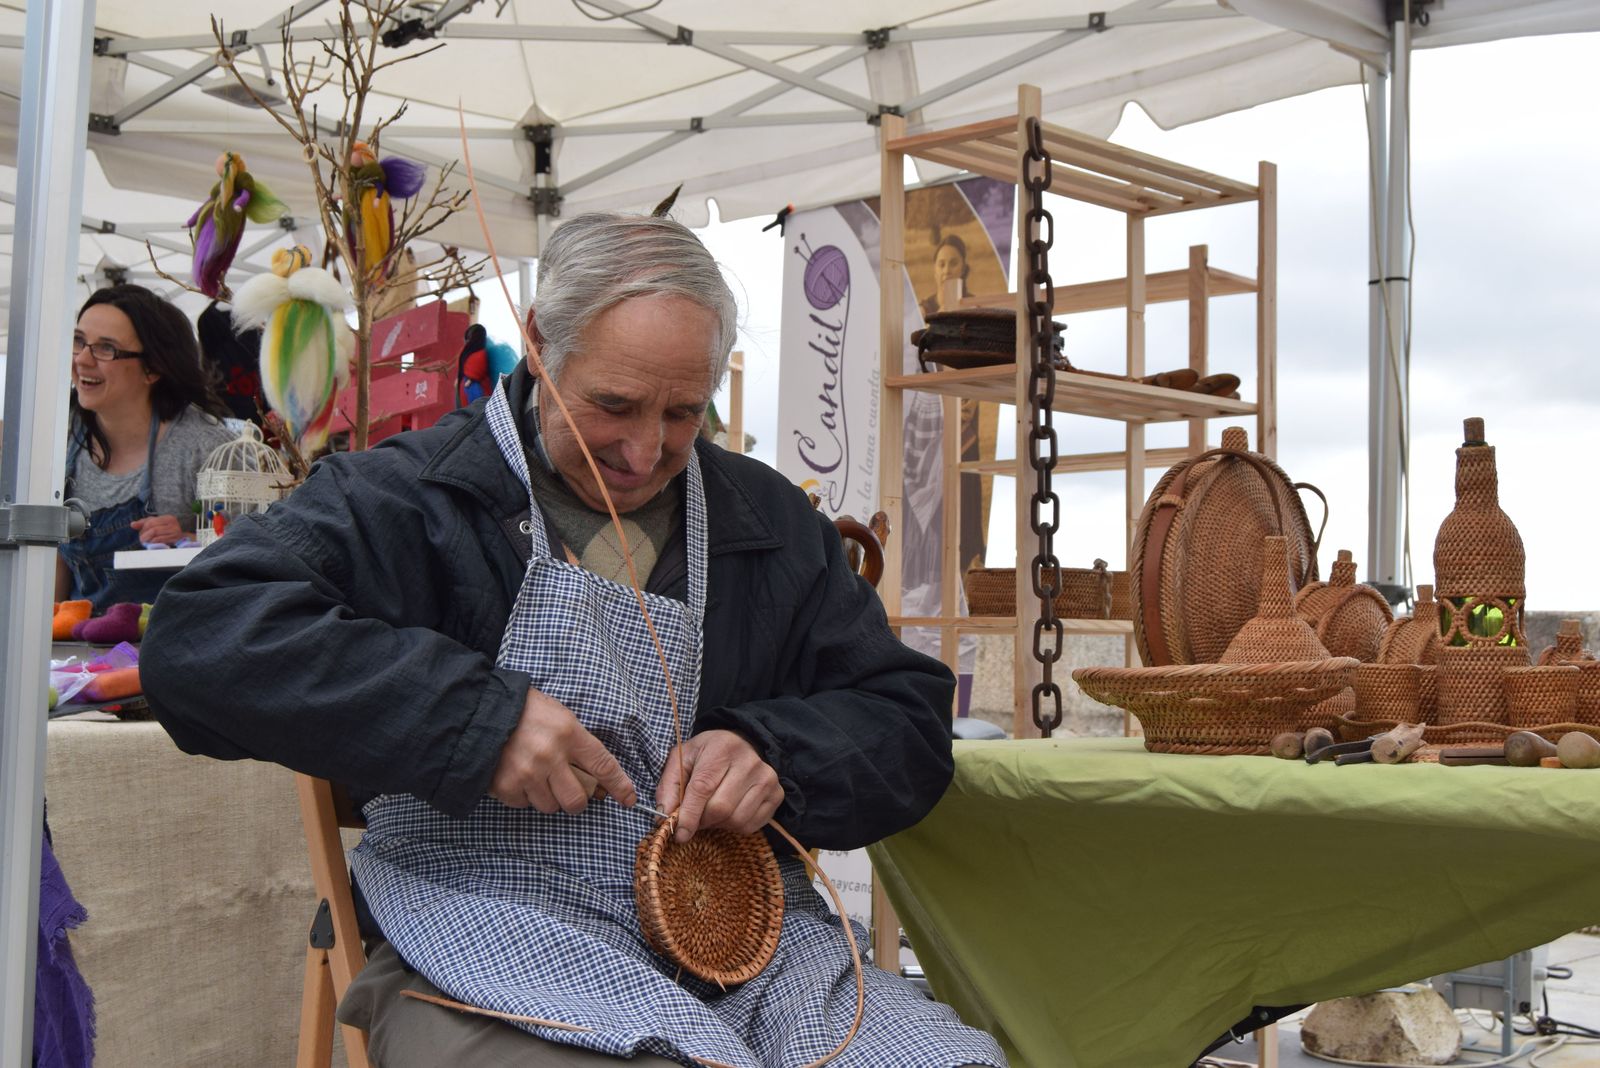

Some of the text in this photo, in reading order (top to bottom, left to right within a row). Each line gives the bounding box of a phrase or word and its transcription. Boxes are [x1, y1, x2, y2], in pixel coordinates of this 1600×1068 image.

[793, 313, 843, 474] Candil
[867, 367, 880, 429] cuenta
[858, 434, 877, 477] lana
[857, 480, 873, 501] la
